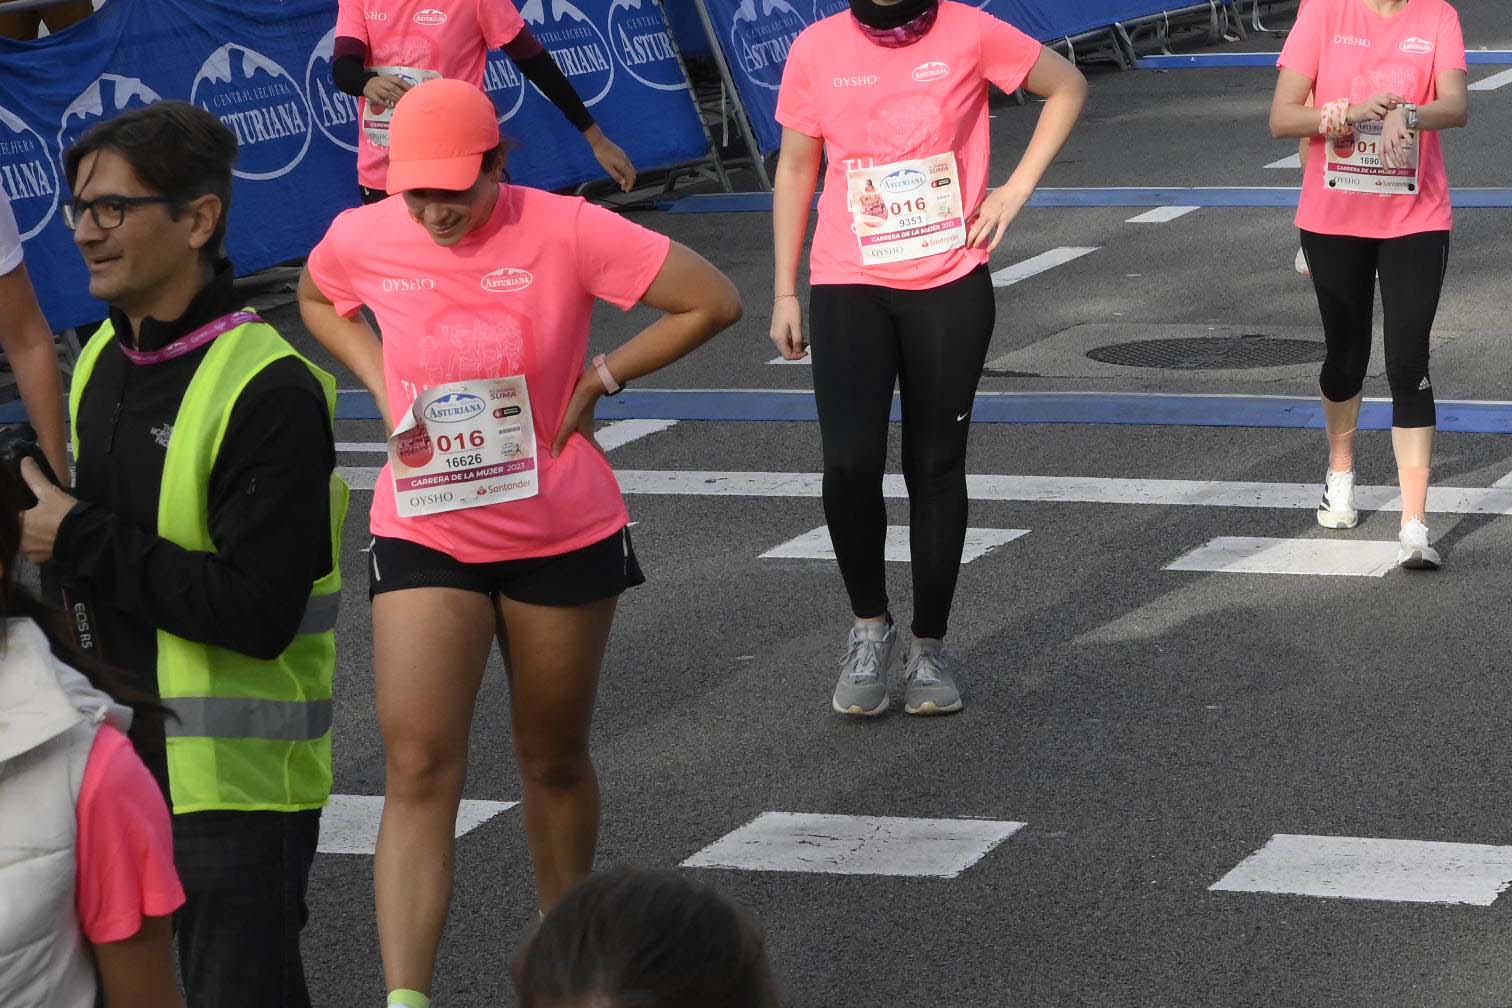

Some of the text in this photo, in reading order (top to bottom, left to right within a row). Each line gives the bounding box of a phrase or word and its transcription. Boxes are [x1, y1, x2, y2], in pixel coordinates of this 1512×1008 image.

[833, 75, 878, 88] OYSHO
[890, 197, 926, 216] 016
[899, 216, 923, 228] 9353
[871, 246, 904, 257] OYSHO
[382, 277, 435, 292] OYSHO
[484, 273, 531, 289] ASTURIANA
[490, 390, 517, 401] SUMA
[429, 403, 482, 419] ASTURIANA
[436, 430, 485, 453] 016
[446, 453, 483, 469] 16626
[410, 462, 525, 488] CARRERA DE LA MUJER 2023
[488, 479, 531, 494] Santander
[410, 490, 454, 507] OYSHO
[75, 602, 93, 649] EOS R5
